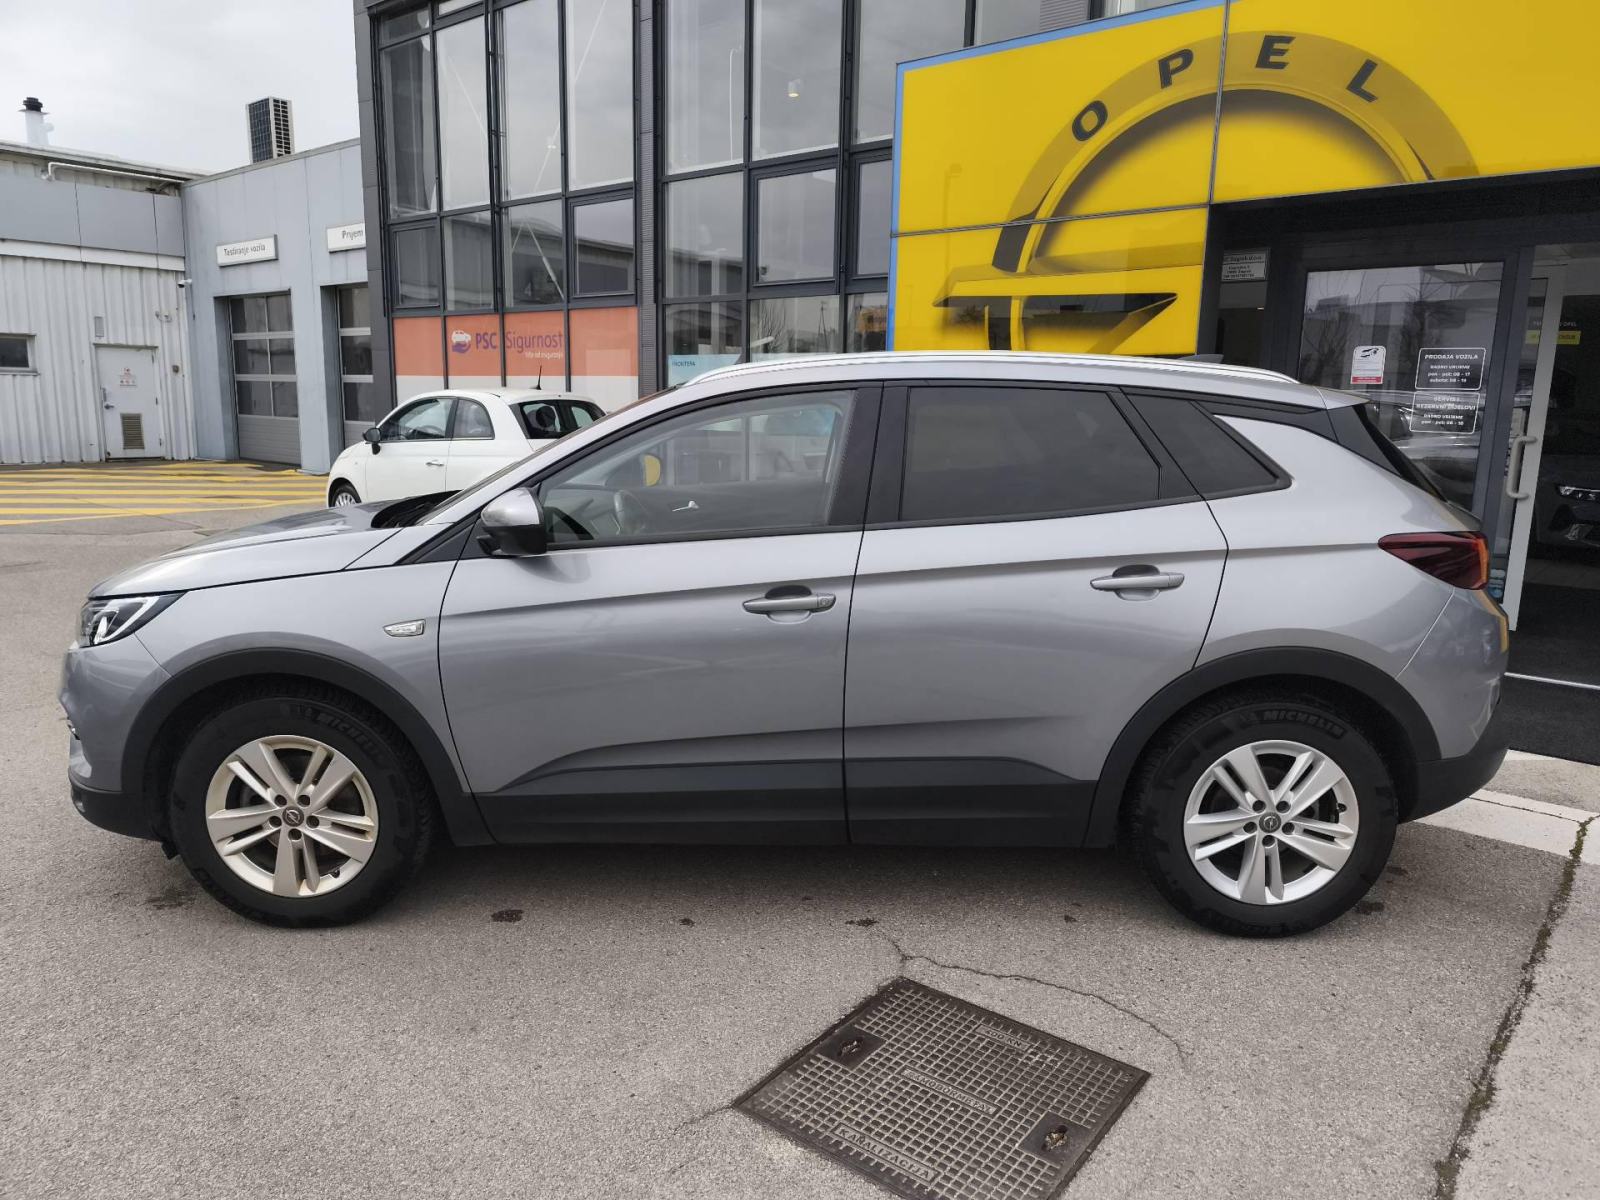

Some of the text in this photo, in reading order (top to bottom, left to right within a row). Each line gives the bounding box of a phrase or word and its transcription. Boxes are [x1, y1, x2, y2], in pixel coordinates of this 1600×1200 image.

[1071, 34, 1379, 142] OPEL
[223, 247, 250, 258] Testiranje
[475, 331, 564, 354] PSC Sigurnost
[1263, 710, 1344, 736] MICHELIN
[838, 1127, 931, 1179] KANALIZACIJA
